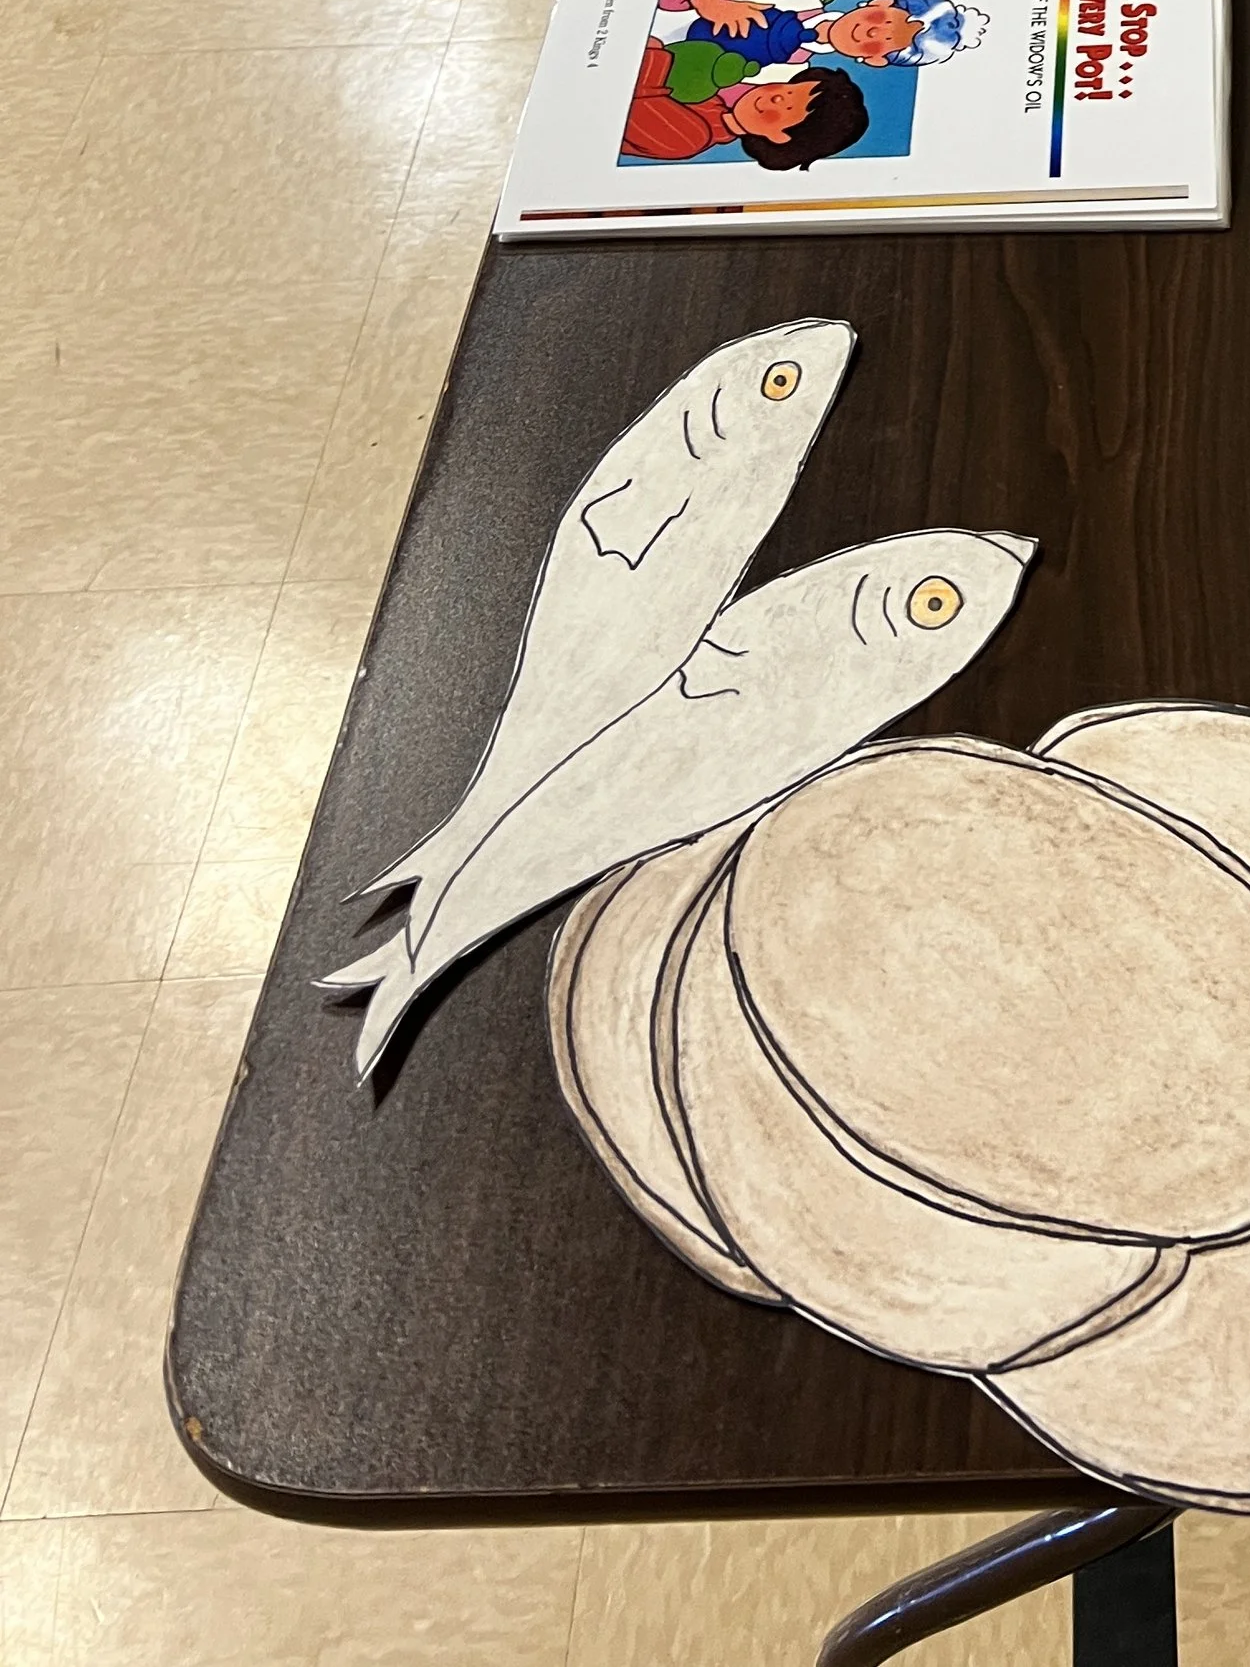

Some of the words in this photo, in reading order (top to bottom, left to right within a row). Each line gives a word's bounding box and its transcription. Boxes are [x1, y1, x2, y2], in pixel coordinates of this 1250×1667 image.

[598, 9, 614, 28] from
[1030, 5, 1048, 27] THE
[1026, 30, 1045, 86] WIDOW'S
[1024, 90, 1042, 113] OIL
